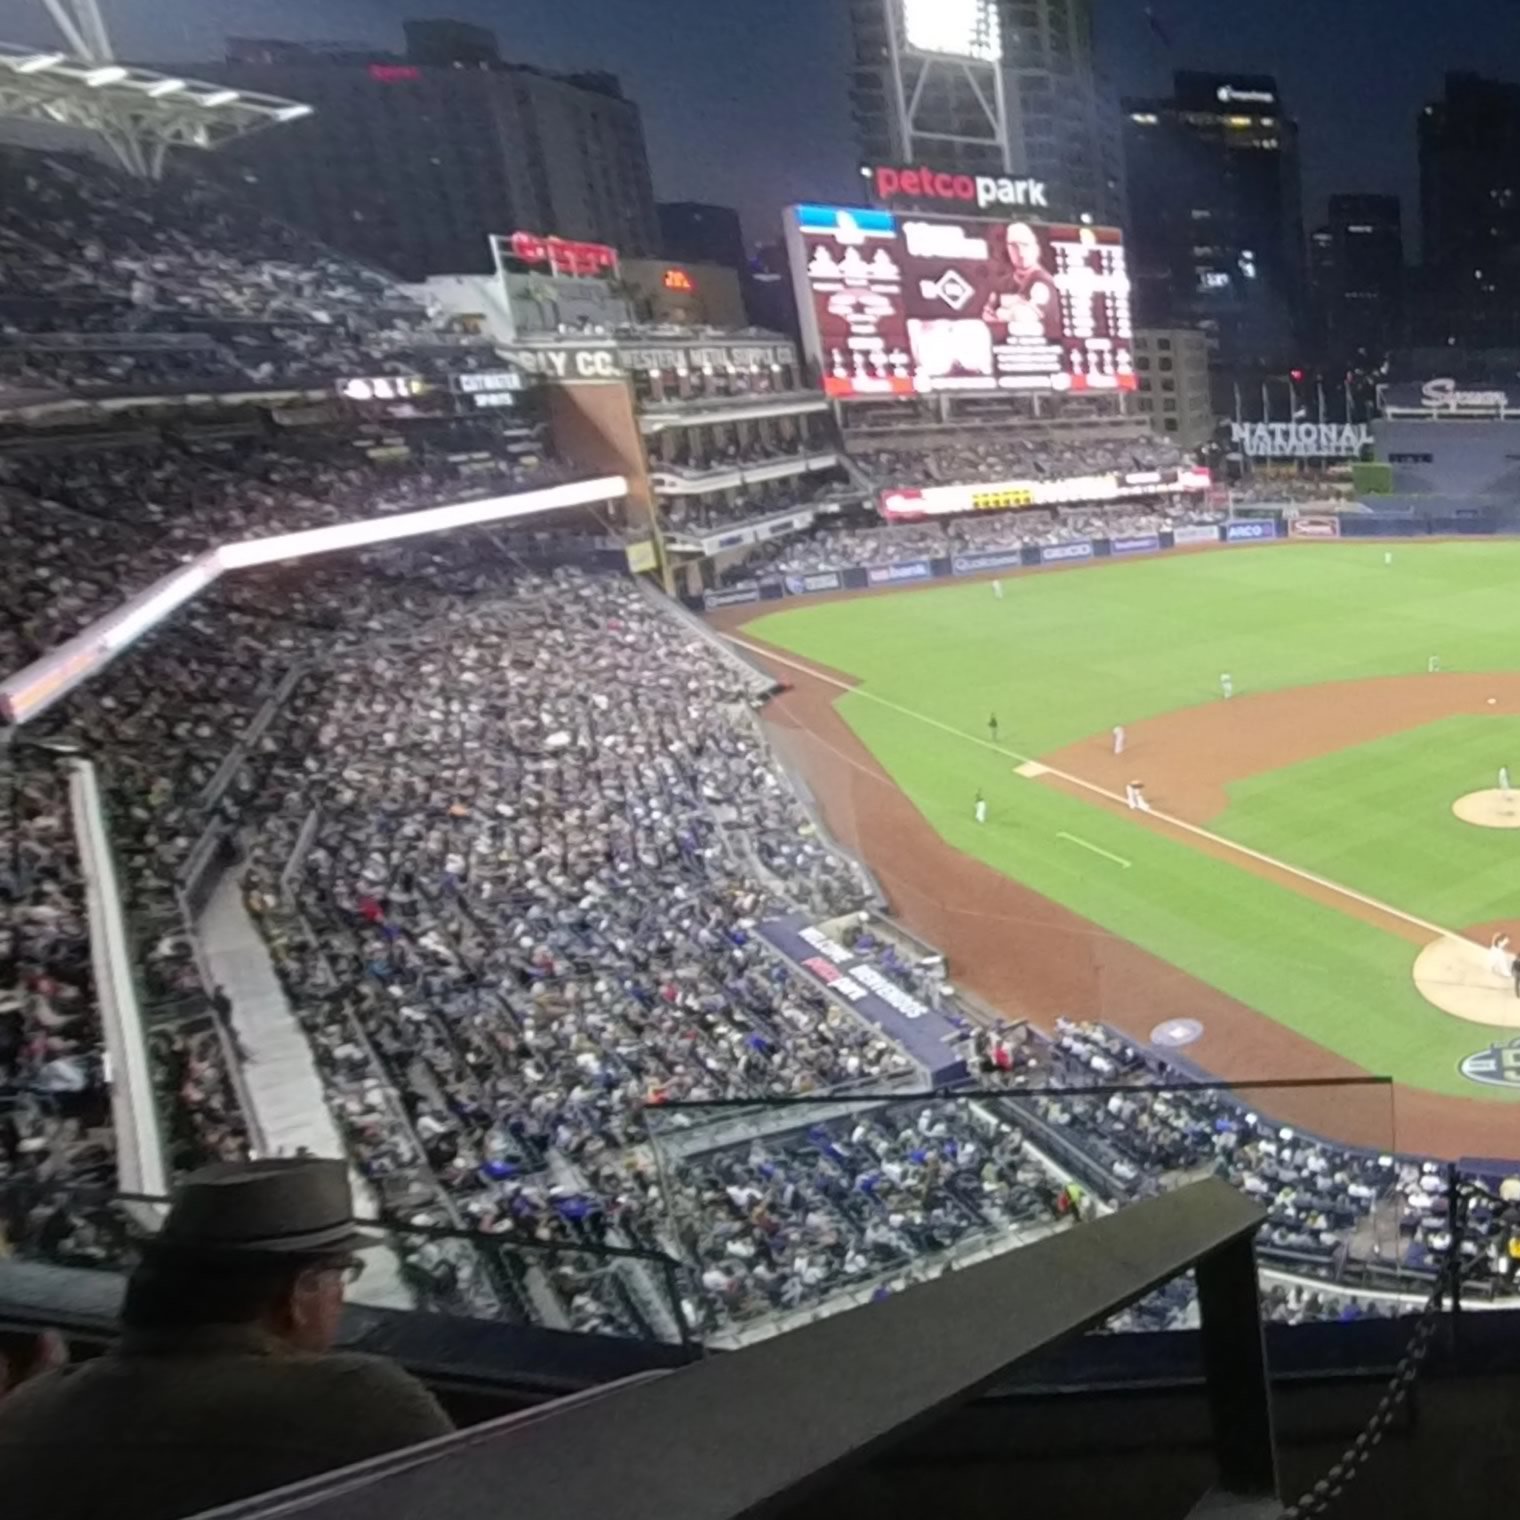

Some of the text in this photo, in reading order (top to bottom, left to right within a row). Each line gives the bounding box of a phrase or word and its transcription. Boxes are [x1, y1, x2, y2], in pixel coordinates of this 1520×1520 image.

[1230, 421, 1375, 444] NATIONAL
[1242, 439, 1362, 457] UNIVERSITY
[1229, 524, 1262, 538] ARCO
